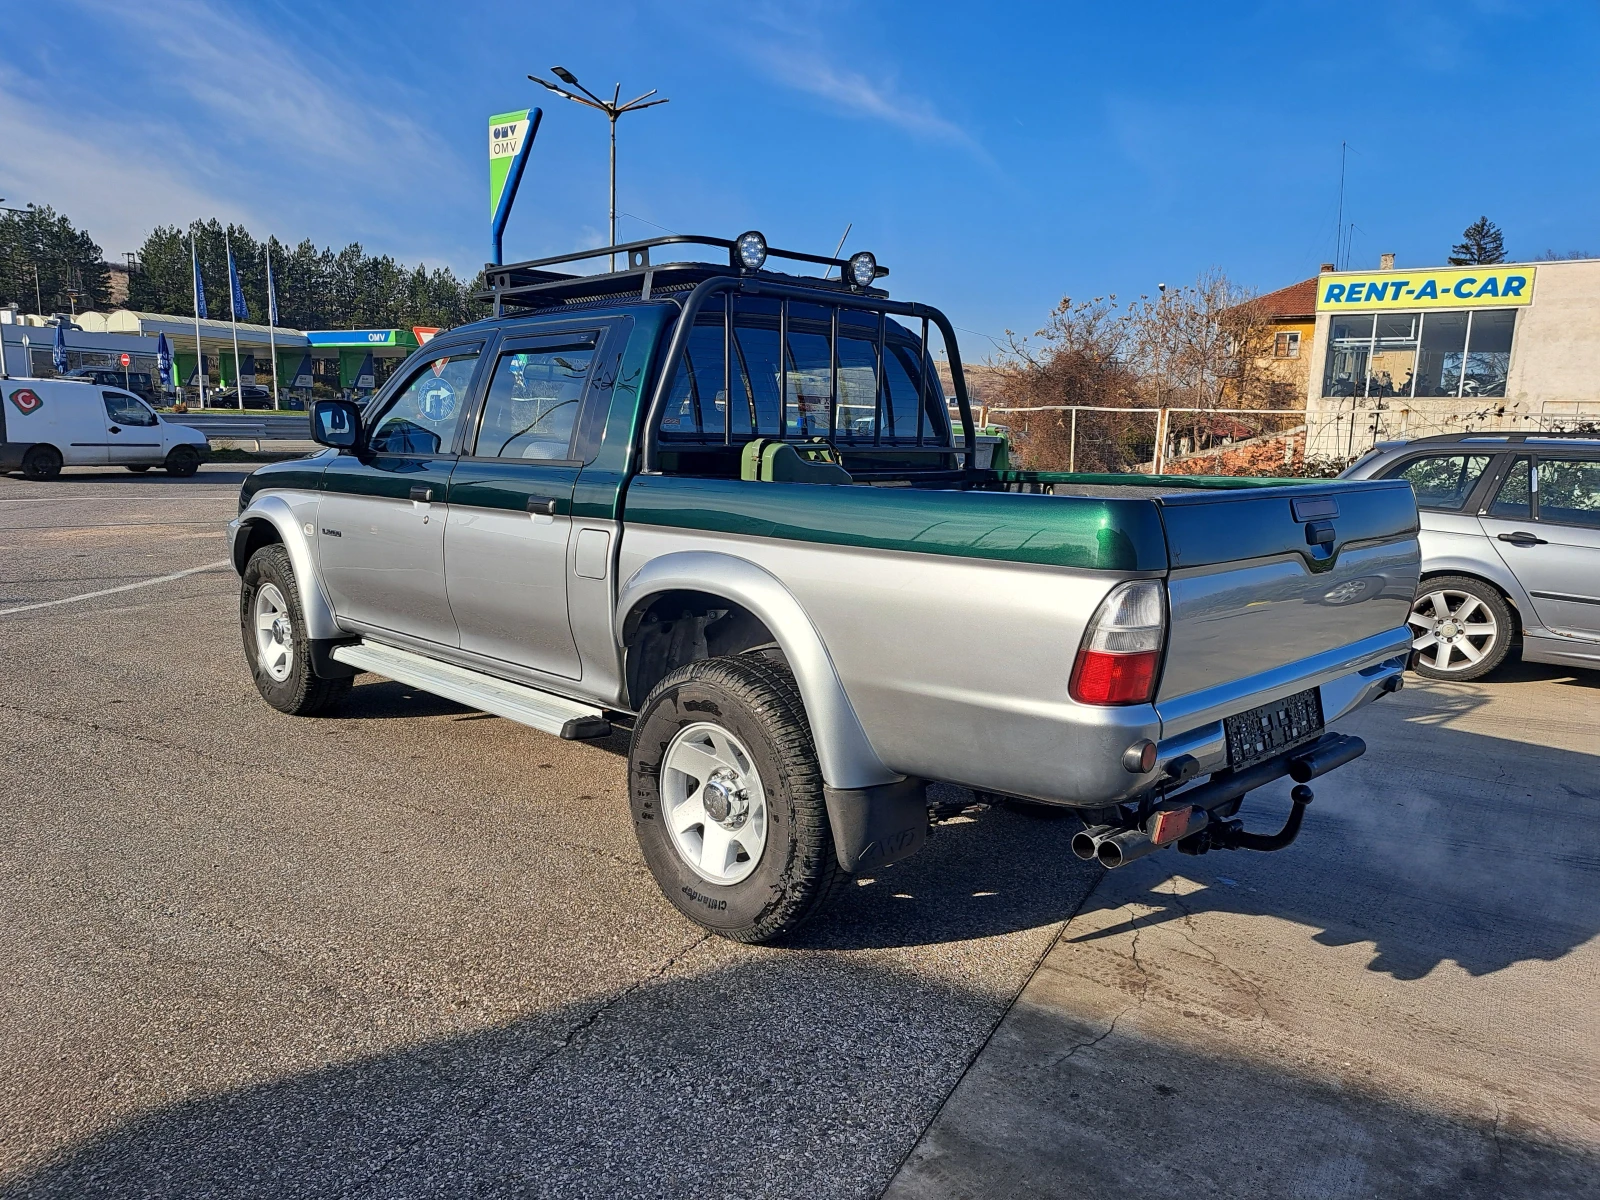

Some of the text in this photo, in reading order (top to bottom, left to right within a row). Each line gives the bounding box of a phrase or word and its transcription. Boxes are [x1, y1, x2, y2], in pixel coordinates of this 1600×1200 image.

[493, 141, 517, 155] OMV
[1324, 276, 1527, 303] RENT-A-CAR
[368, 333, 386, 342] OMV
